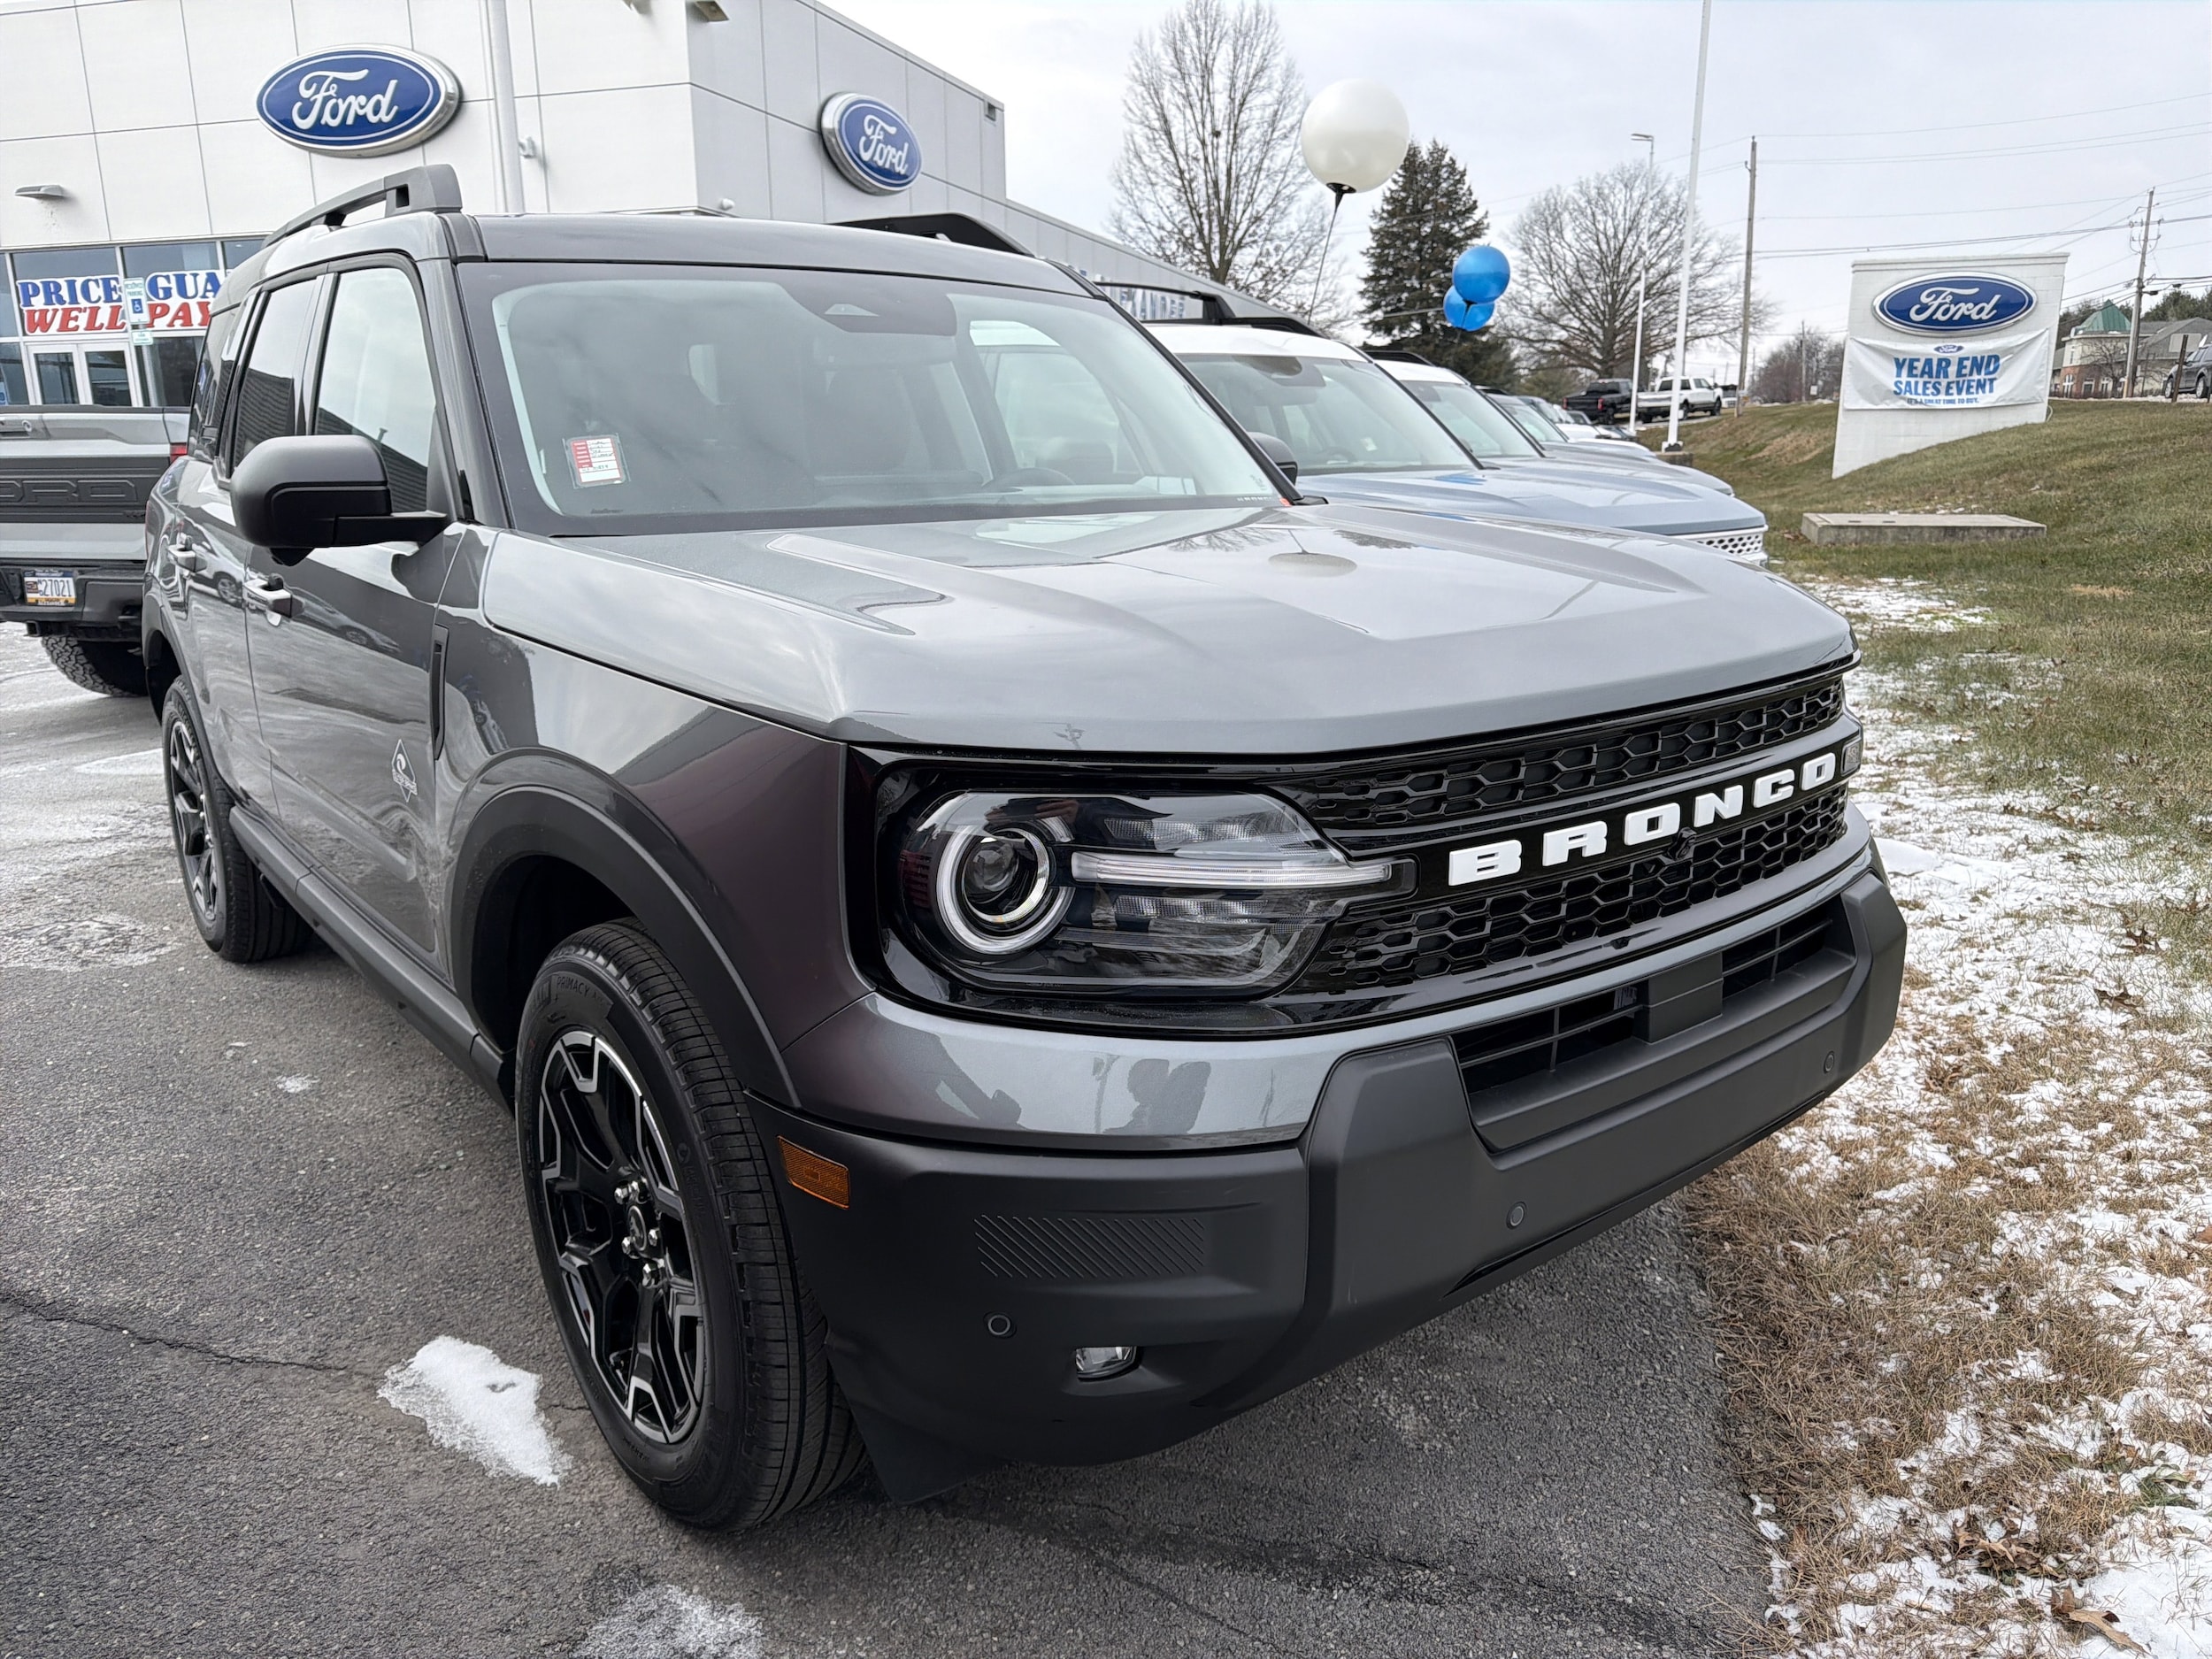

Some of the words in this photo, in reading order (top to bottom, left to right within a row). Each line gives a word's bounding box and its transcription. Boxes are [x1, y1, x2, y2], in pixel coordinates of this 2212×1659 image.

[291, 68, 398, 130] Ford
[858, 114, 910, 175] Ford
[18, 276, 123, 308] PRICE
[1909, 286, 2001, 323] Ford
[25, 304, 126, 334] WE'LL
[1893, 356, 1952, 380] YEAR
[1955, 354, 2001, 378] END
[1893, 380, 1942, 396] SALES
[1945, 377, 1997, 396] EVENT
[1448, 750, 1837, 887] BRONCO
[556, 975, 590, 998] PRIMACY
